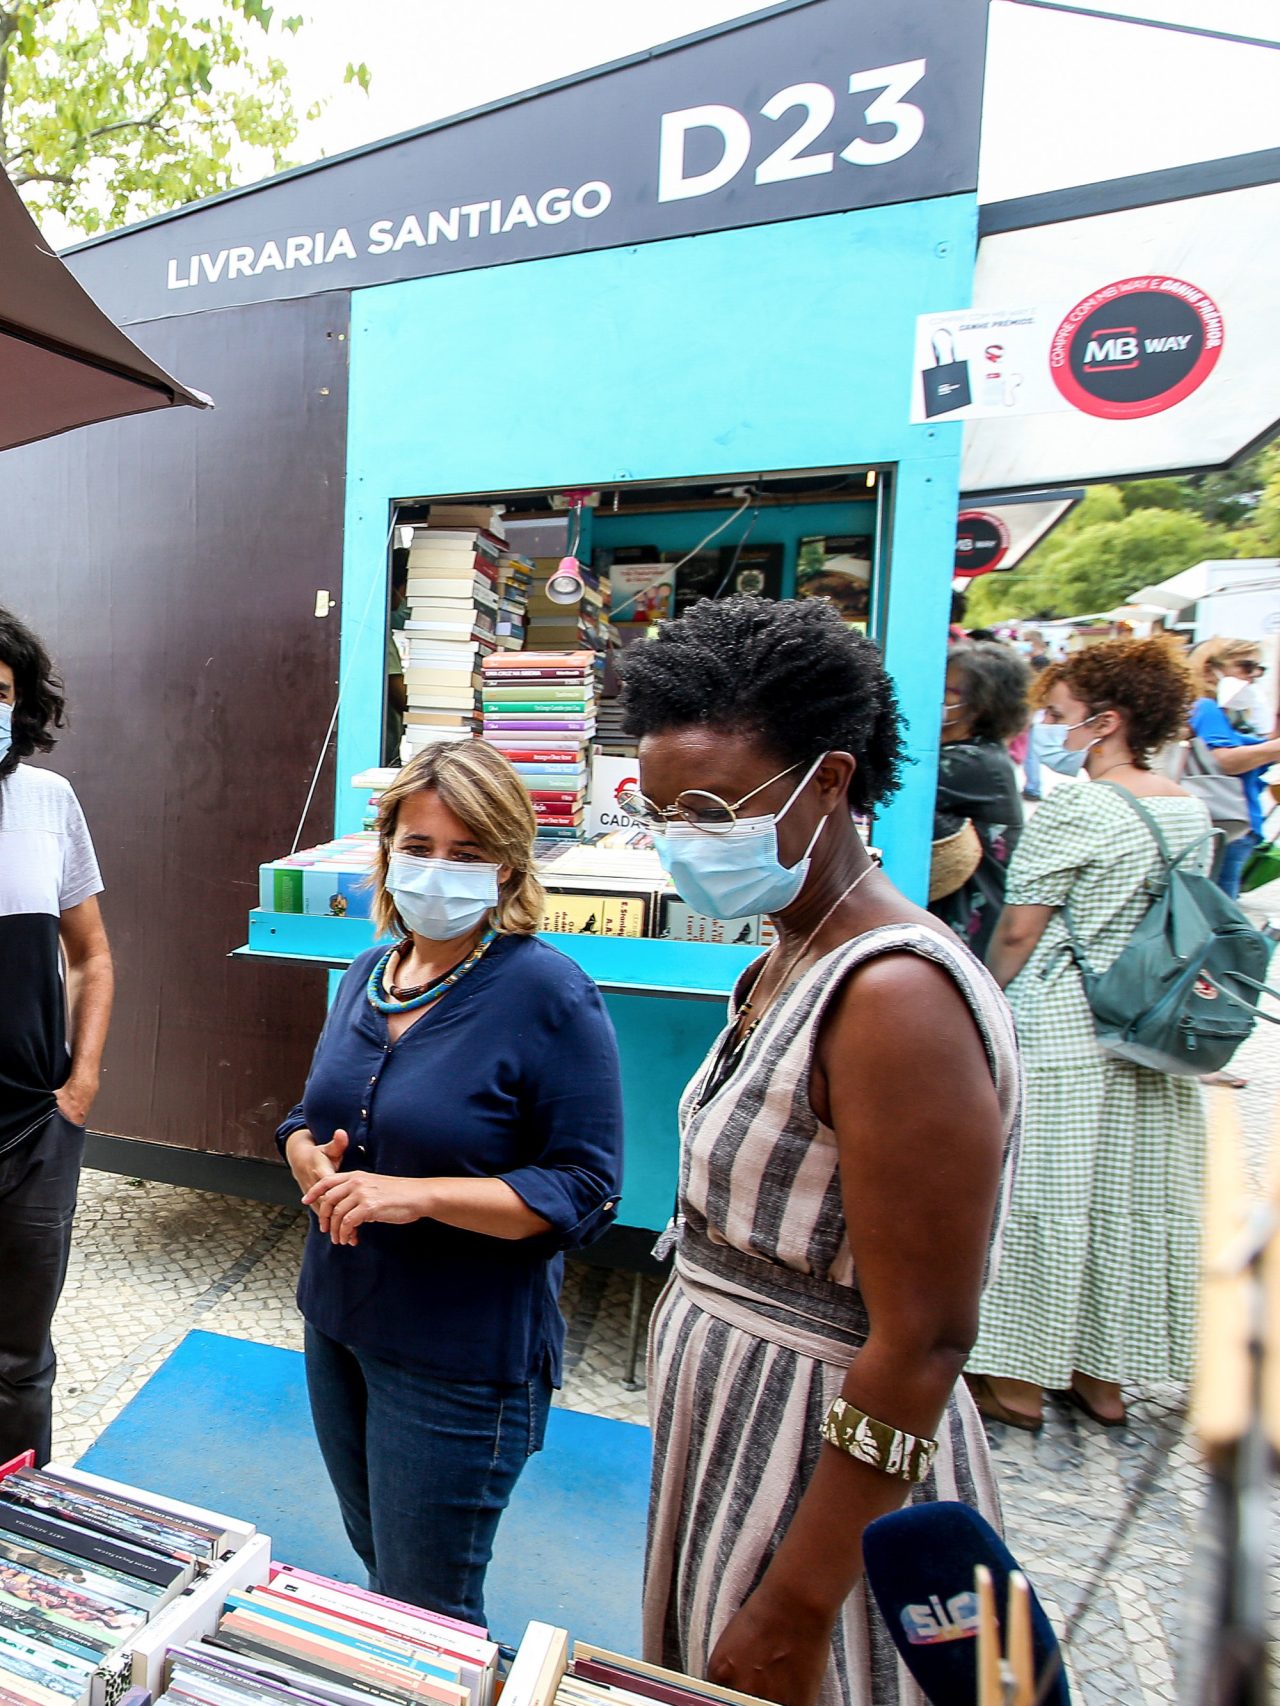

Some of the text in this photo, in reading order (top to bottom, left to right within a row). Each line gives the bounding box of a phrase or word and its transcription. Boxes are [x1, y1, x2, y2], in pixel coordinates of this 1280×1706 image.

[658, 58, 926, 203] D23
[166, 179, 612, 290] LIVRARIA SANTIAGO
[1150, 278, 1160, 289] E
[1084, 334, 1193, 363] MB WAY
